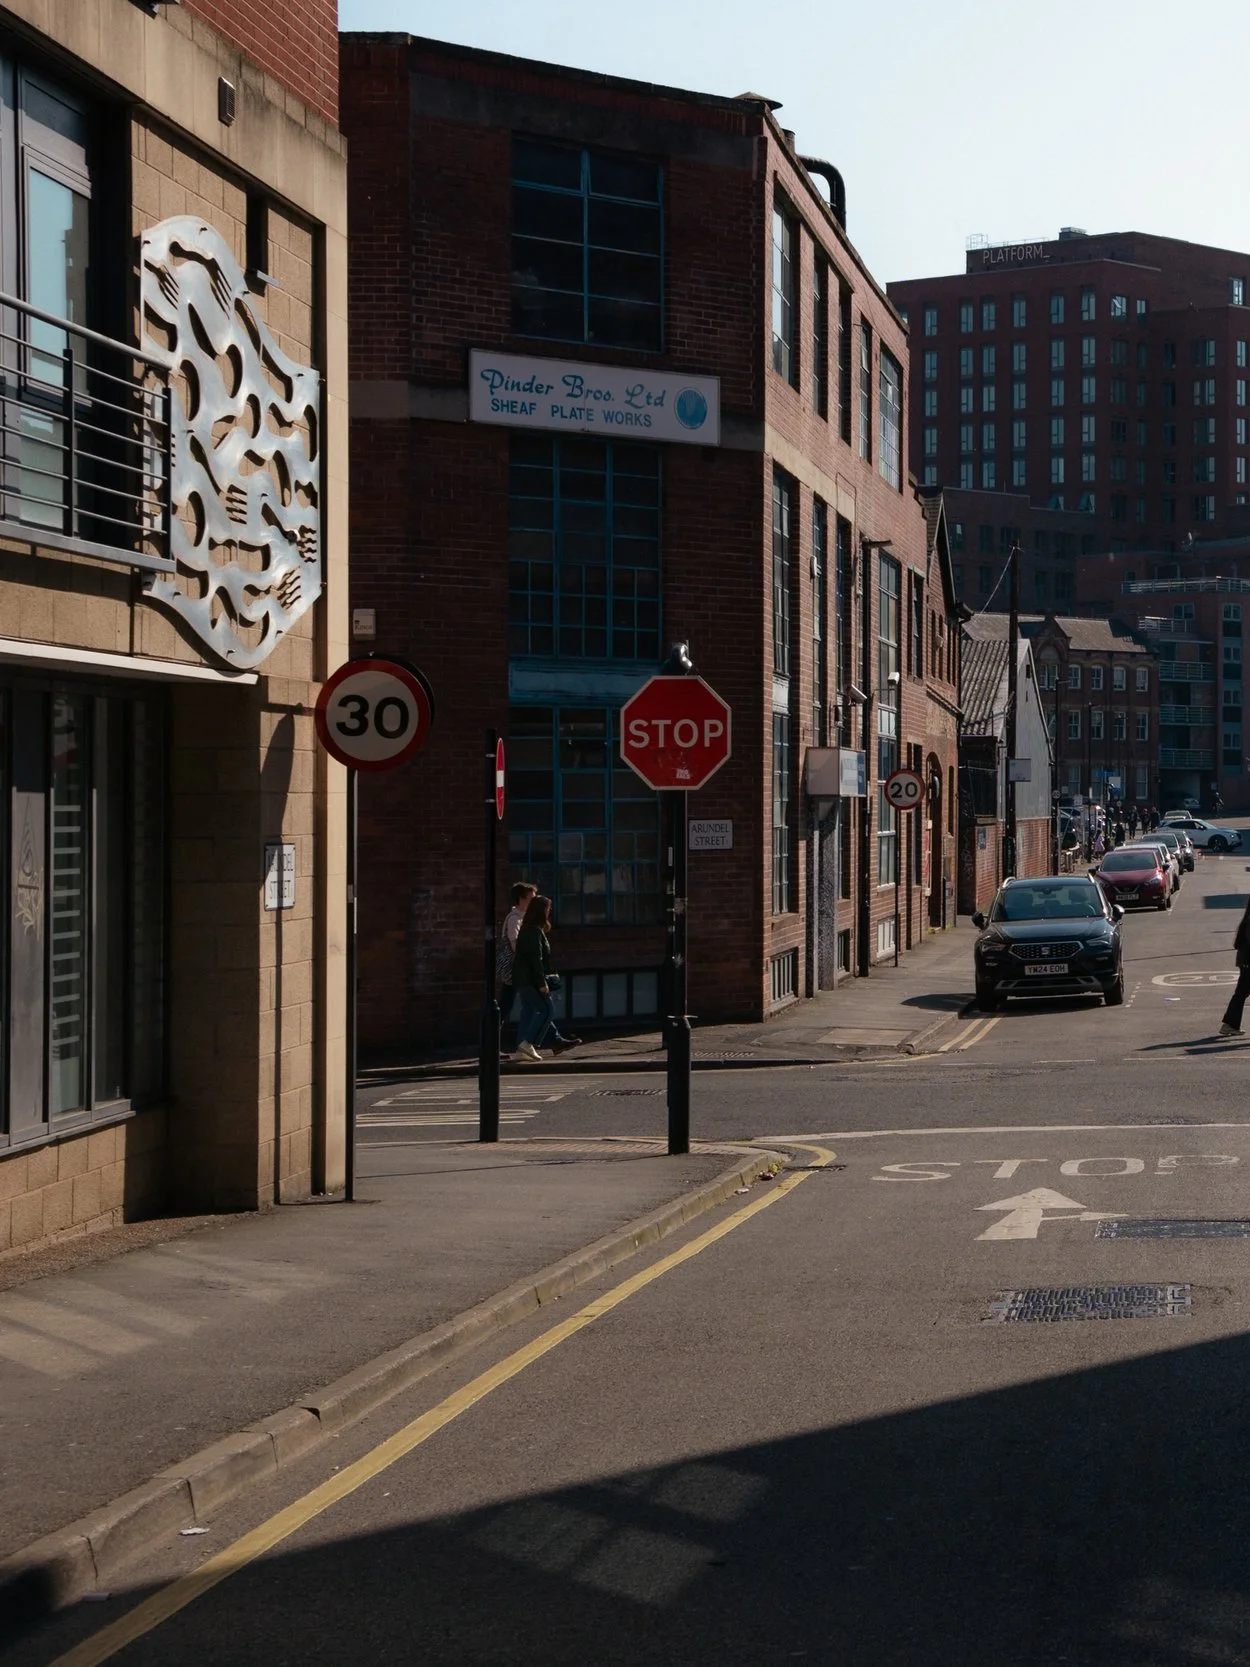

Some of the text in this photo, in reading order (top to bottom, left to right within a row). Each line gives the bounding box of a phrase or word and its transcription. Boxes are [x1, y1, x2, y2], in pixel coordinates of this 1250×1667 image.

[480, 368, 667, 409] Pinder Bros. Ltd
[491, 398, 652, 428] SHEAF PLATE WORKS
[336, 694, 409, 739] 30
[628, 718, 724, 749] STOP
[890, 782, 918, 798] 20
[691, 823, 730, 833] ARUNDEL
[694, 836, 727, 846] STREET
[870, 1154, 1240, 1182] STOP
